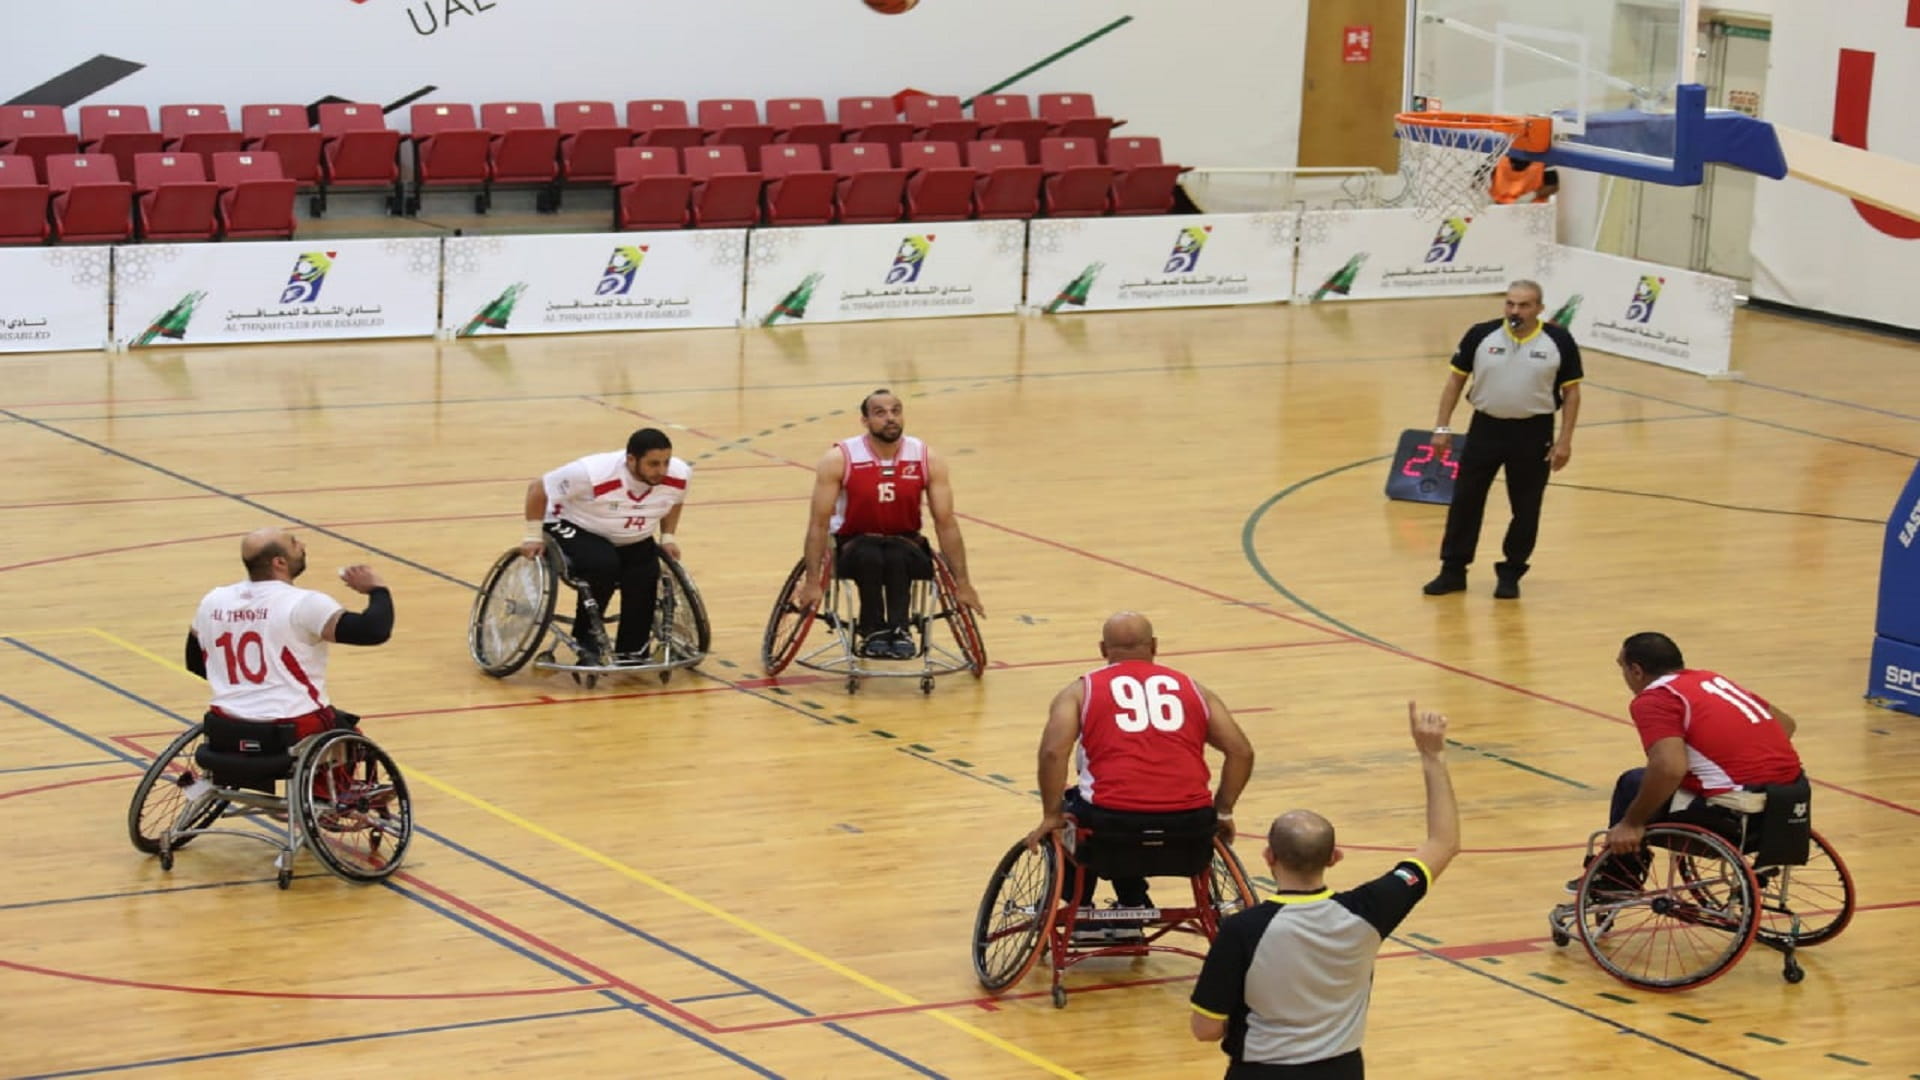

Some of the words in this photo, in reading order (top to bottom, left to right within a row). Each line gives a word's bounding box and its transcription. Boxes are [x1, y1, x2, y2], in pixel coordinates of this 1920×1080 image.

[1403, 445, 1460, 480] 24
[877, 482, 896, 503] 15
[1898, 498, 1920, 548] EAS
[215, 631, 268, 685] 10
[1110, 675, 1185, 733] 96
[1701, 676, 1773, 724] 11
